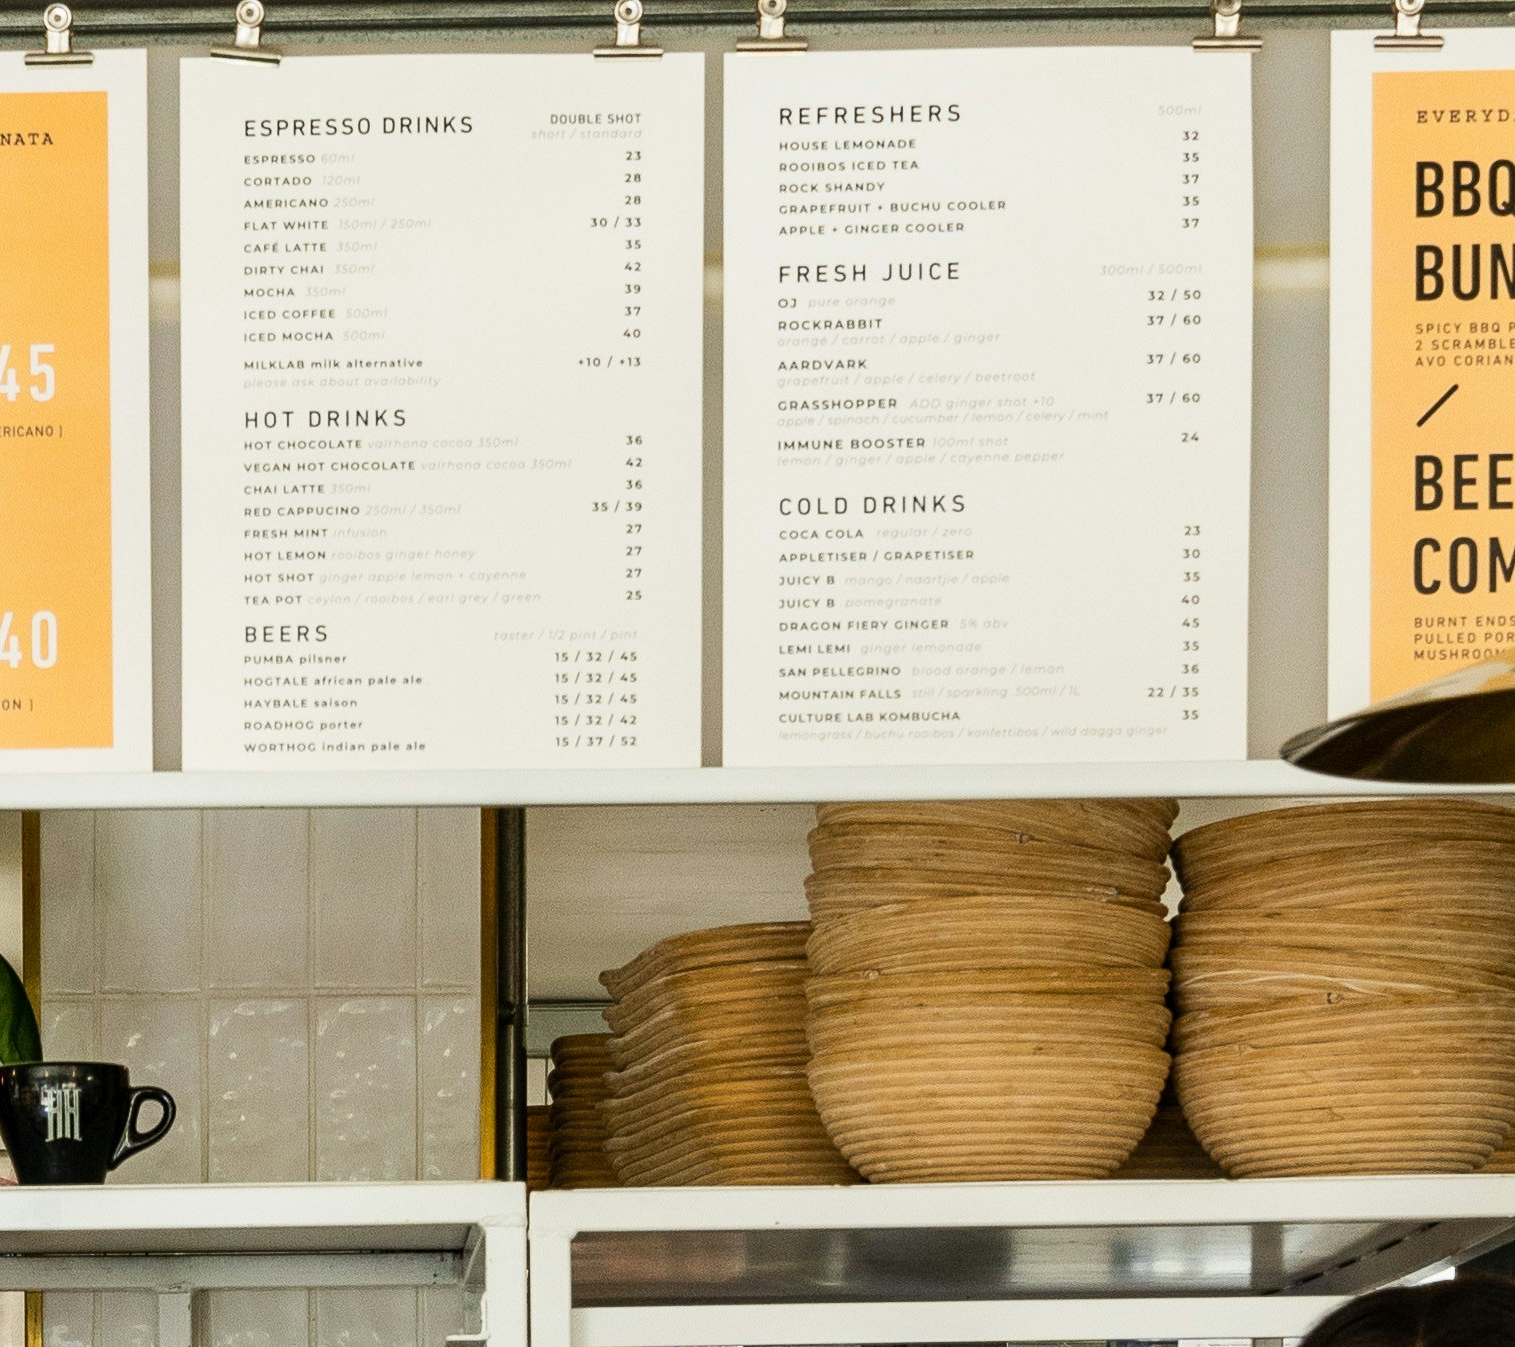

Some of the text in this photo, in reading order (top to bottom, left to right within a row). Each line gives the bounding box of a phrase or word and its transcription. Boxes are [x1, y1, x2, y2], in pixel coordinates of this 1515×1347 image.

[550, 113, 641, 125] DOUBLE SHOT
[780, 104, 960, 125] REFRESHERS
[245, 116, 472, 137] ESPRESSO DRINKS
[0, 132, 54, 146] NATA
[1184, 131, 1199, 141] 32
[779, 139, 915, 151] HOUSE LEMONADE
[244, 154, 315, 164] ESPRESSO
[626, 151, 641, 161] 23
[779, 160, 918, 172] ROOIBOS ICED TEA
[244, 242, 326, 253] CAFÉ LATTE
[779, 262, 959, 283] FRESH JUICE
[778, 319, 882, 331] ROCKRABBIT
[244, 359, 423, 370] MILKLAB milk alternative
[1415, 355, 1446, 367] AVO
[245, 409, 406, 428] HOT DRINKS
[779, 494, 965, 516] COLD DRINKS
[779, 529, 863, 540] COCA COLA
[1185, 525, 1200, 536] 23
[245, 625, 327, 643] BEERS
[779, 689, 901, 700] MOUNTAIN FALLS
